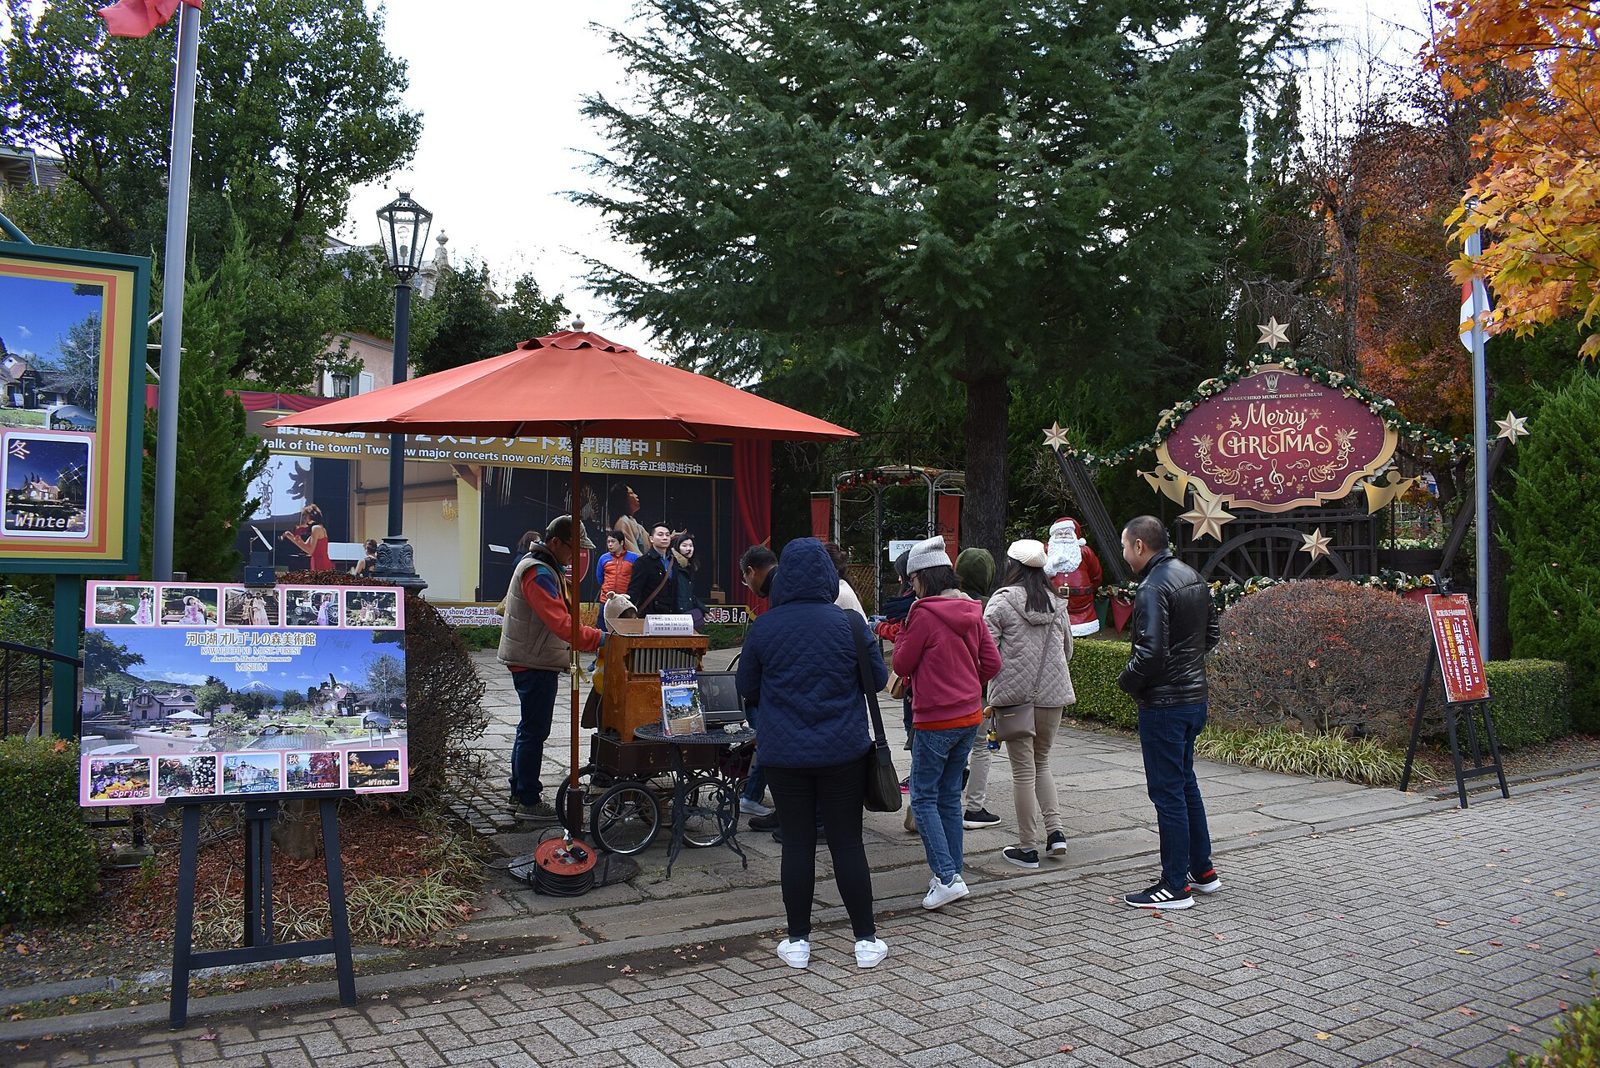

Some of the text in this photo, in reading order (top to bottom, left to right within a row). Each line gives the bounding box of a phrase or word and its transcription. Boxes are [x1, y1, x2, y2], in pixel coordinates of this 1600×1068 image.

[1242, 403, 1307, 431] Merry
[8, 440, 31, 460] 冬
[263, 438, 285, 450] talk
[289, 440, 302, 450] of
[306, 440, 325, 451] the
[328, 441, 361, 454] town!
[365, 444, 389, 455] Two
[418, 448, 451, 459] major
[454, 450, 499, 461] concerts
[502, 453, 524, 462] now
[160, 758, 181, 769] バラ
[287, 754, 300, 765] 秋
